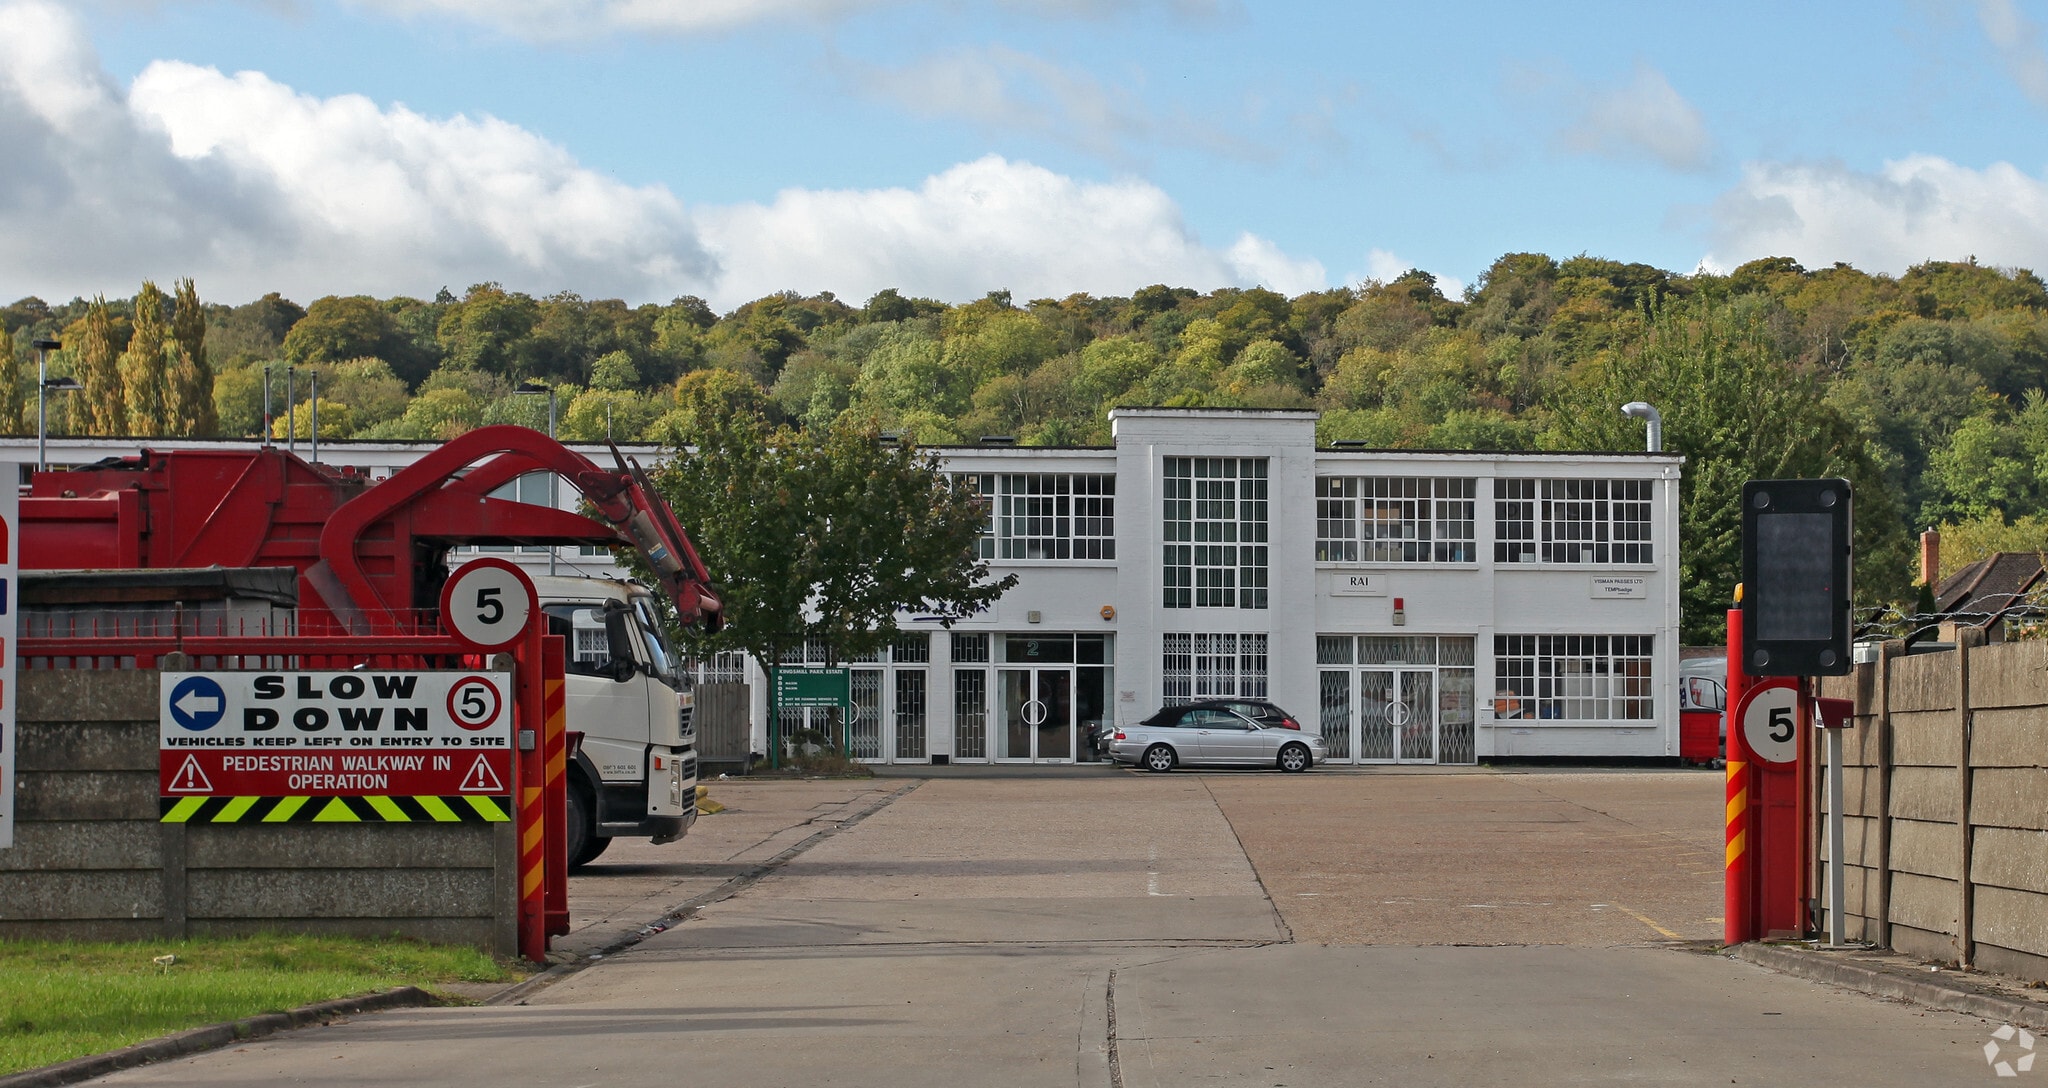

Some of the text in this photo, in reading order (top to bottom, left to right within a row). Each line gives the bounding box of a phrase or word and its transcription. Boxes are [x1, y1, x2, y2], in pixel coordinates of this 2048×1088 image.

[1350, 577, 1369, 586] RAI
[477, 588, 504, 624] 5
[1027, 641, 1039, 655] 2
[254, 675, 418, 700] SLOW
[461, 688, 486, 719] 5
[244, 707, 428, 731] DOWN
[1768, 707, 1795, 743] 5
[167, 737, 505, 746] VEHICLES KEEP LEFT ON ENTRY TO SITE
[223, 755, 450, 771] PEDESTRIAN WALKWAY IN
[288, 773, 388, 789] OPERATION
